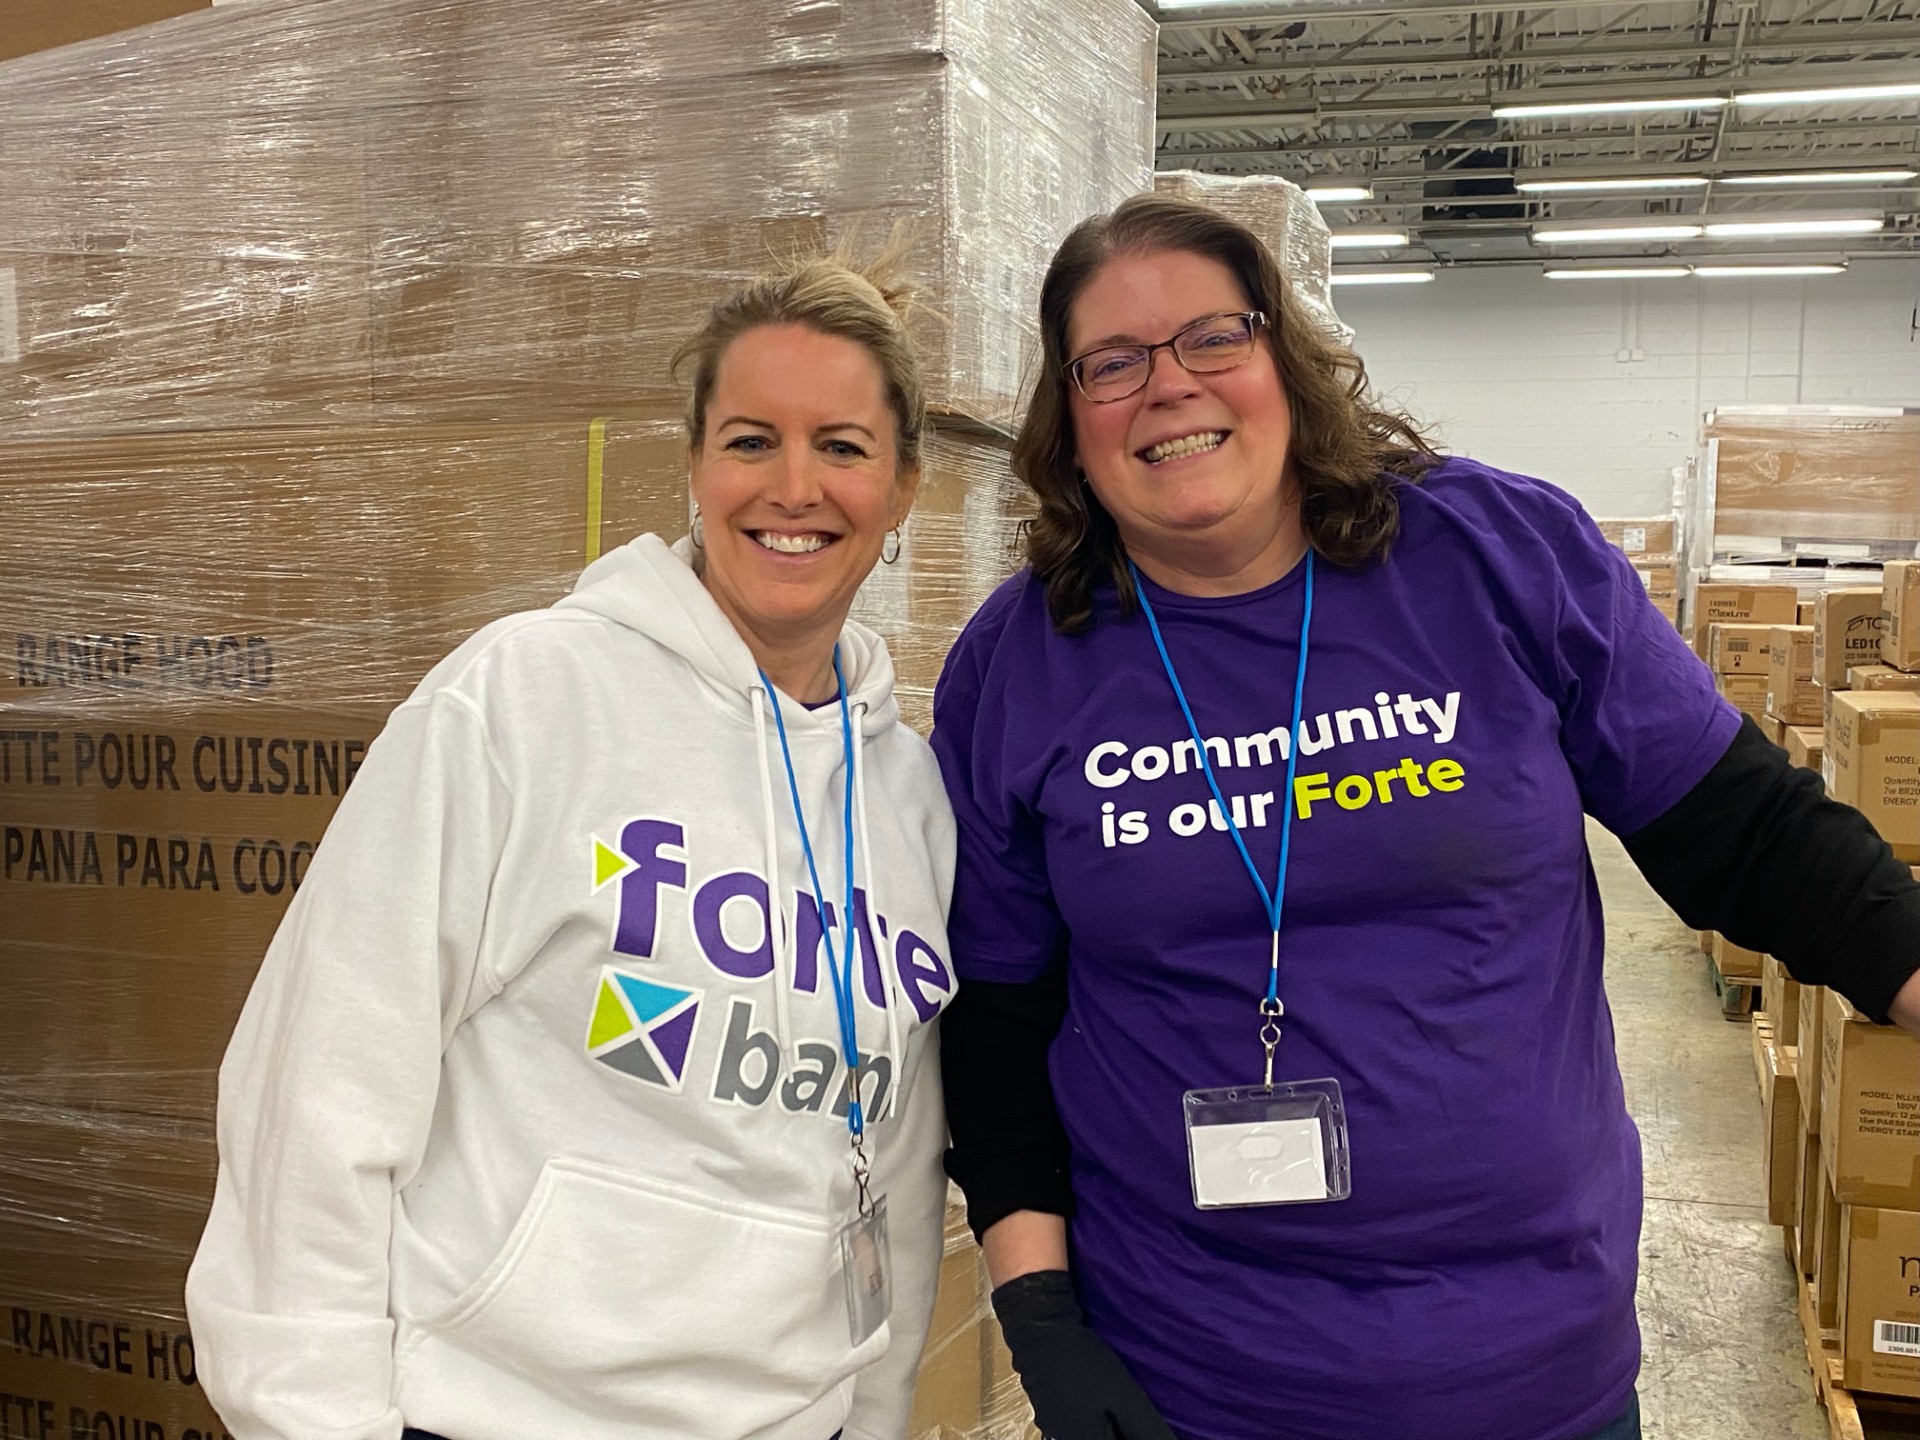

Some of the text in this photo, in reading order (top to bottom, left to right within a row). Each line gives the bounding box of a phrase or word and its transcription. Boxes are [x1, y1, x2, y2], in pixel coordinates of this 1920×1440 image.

[15, 631, 275, 690] RANGE HOOD
[0, 730, 61, 787] TTE
[75, 732, 181, 791] POUR
[1083, 691, 1461, 788] Community
[1100, 757, 1466, 848] is our Forte
[1883, 796, 1918, 806] ENERGY
[4, 827, 319, 896] PANA PARA COC
[611, 817, 953, 1025] forte
[712, 1000, 896, 1123] ban
[1858, 1125, 1895, 1135] ENERGY
[1859, 1108, 1898, 1119] Quantity:
[10, 1307, 134, 1376] RANGE
